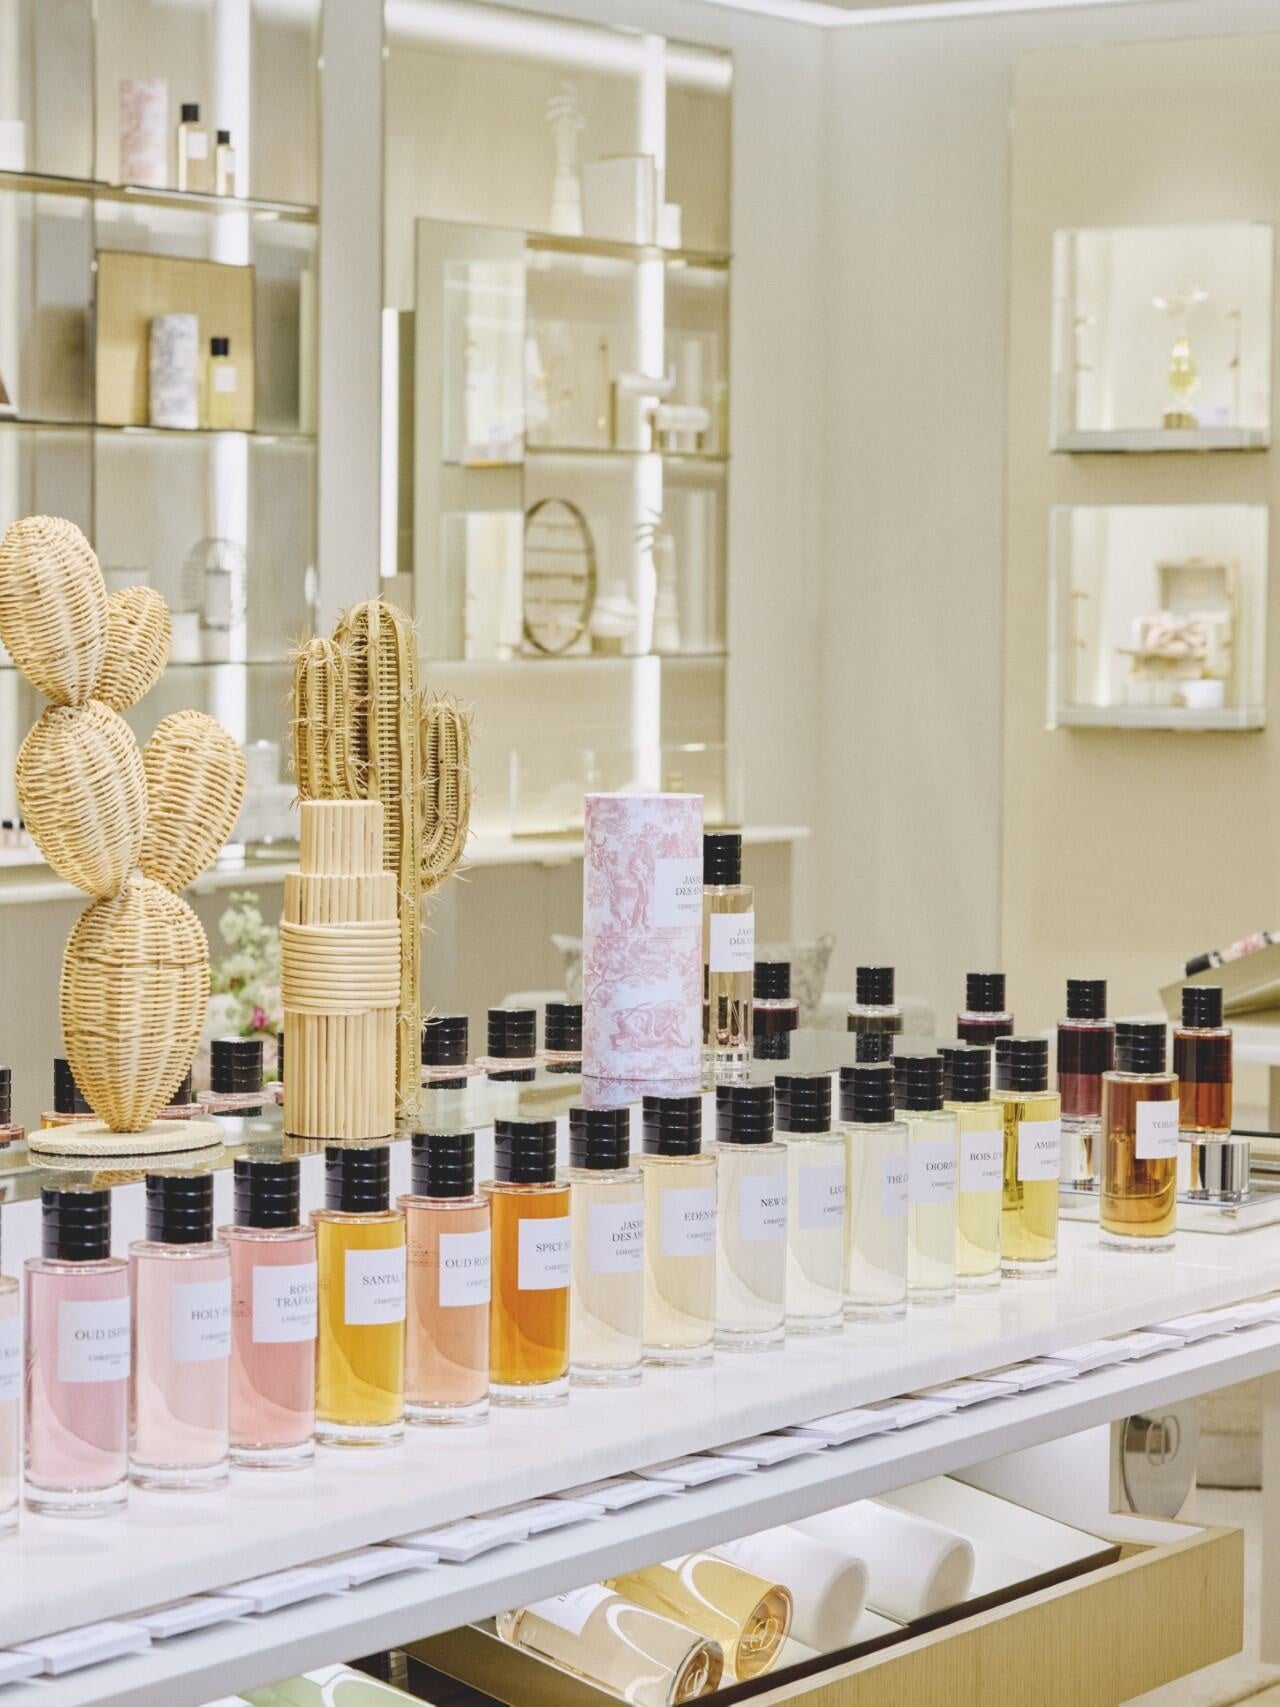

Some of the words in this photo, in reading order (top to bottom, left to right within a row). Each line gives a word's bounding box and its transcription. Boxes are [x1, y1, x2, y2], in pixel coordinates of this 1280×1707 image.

[674, 887, 693, 896] DES
[728, 938, 746, 947] DES
[969, 1151, 991, 1162] BOIS
[760, 1197, 780, 1208] NEW
[611, 1232, 632, 1243] DES
[535, 1241, 563, 1254] SPICE
[445, 1257, 472, 1269] OUD
[361, 1273, 400, 1287] SANTAL
[191, 1308, 219, 1321] HOLY
[74, 1328, 106, 1342] OUD
